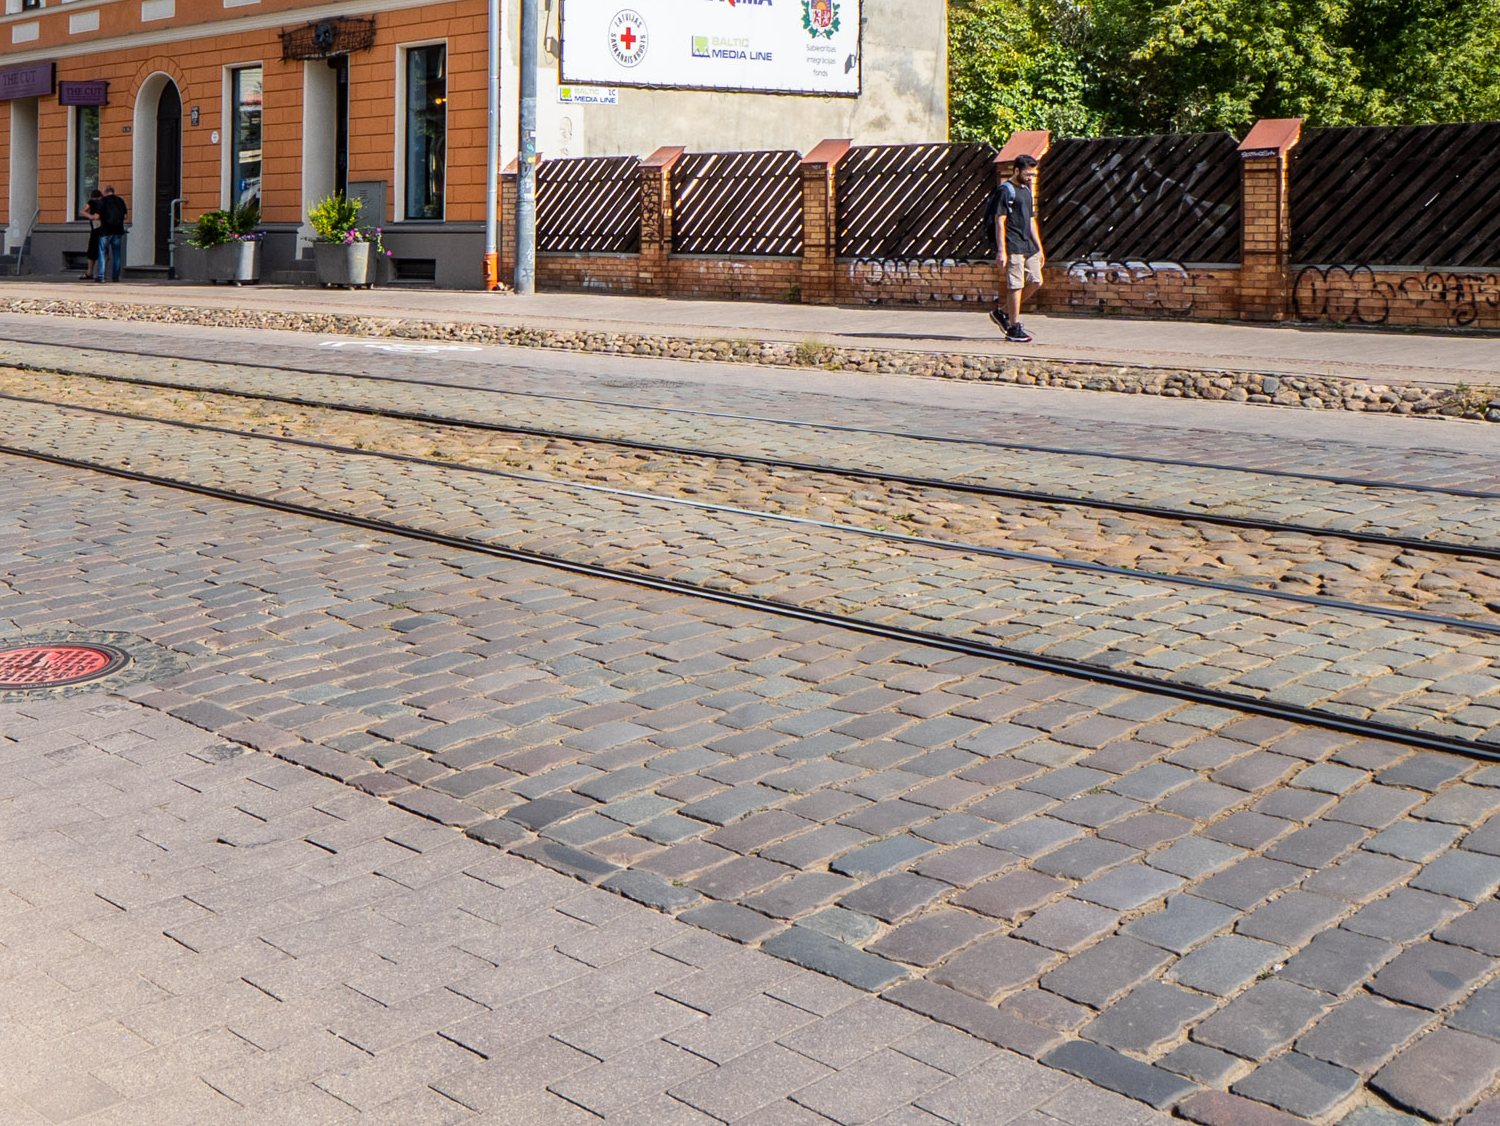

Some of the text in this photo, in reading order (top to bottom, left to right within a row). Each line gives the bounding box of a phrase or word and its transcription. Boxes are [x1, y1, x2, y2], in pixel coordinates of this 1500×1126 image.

[711, 37, 749, 48] BALTIC
[711, 49, 773, 61] MEDIA LINE
[20, 70, 37, 84] CUT
[66, 87, 103, 96] THE CUT
[574, 95, 598, 103] MEDIA
